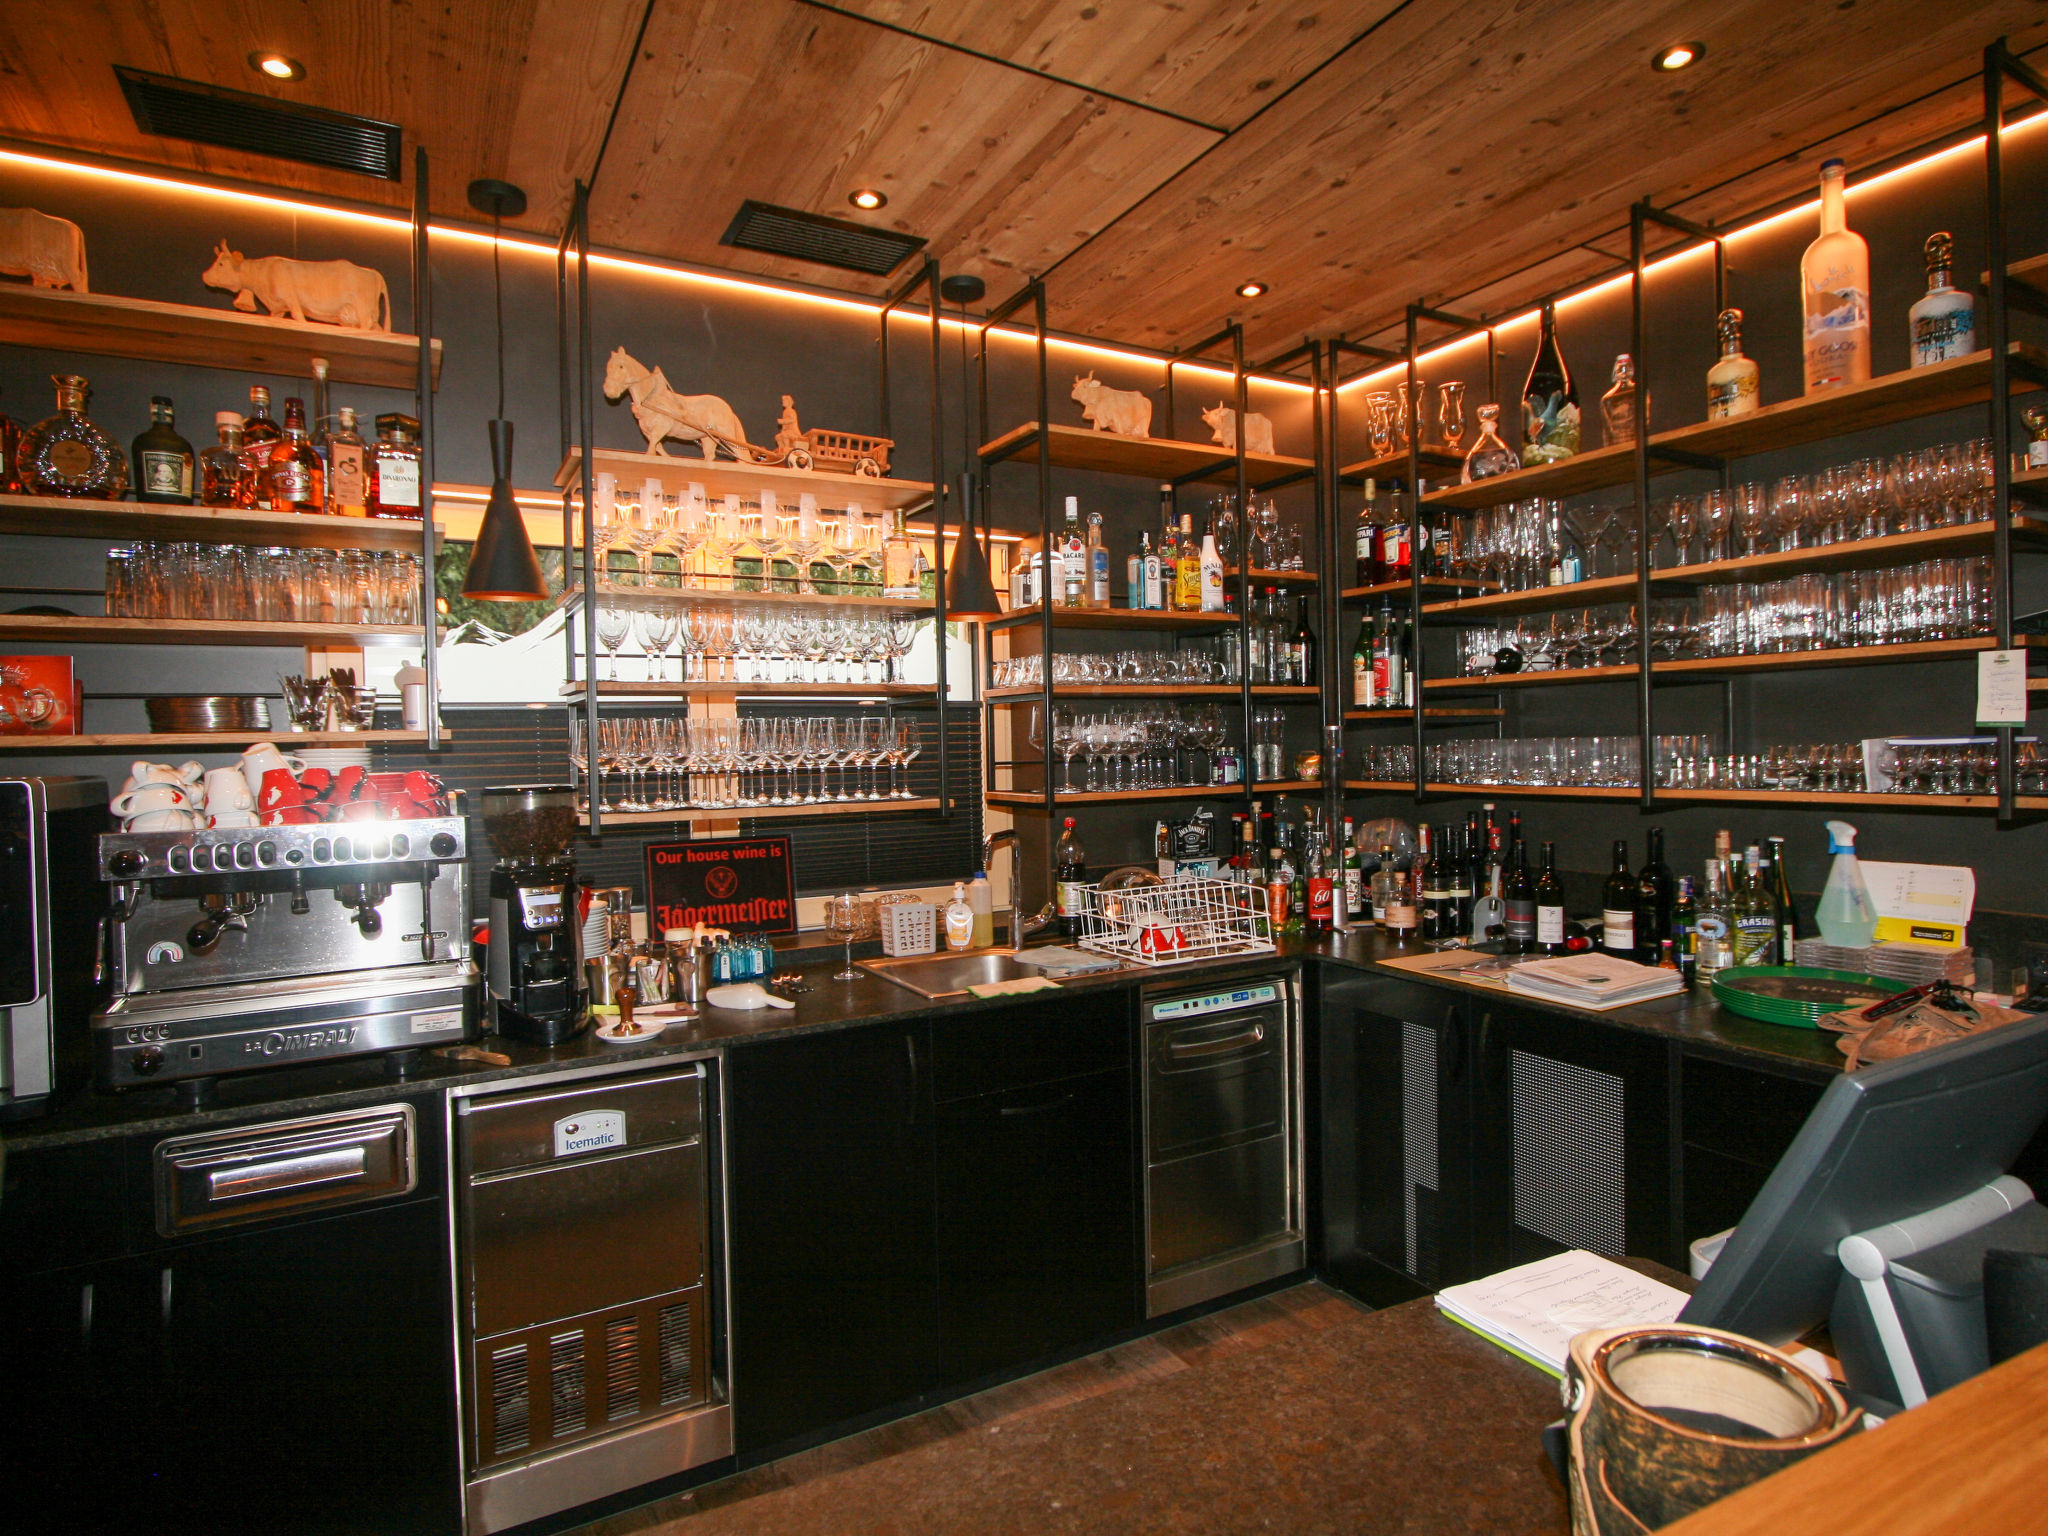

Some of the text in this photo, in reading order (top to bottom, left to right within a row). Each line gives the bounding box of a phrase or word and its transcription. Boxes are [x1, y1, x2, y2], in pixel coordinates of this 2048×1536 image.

[655, 843, 782, 865] Our house wine is
[1314, 889, 1330, 903] 60
[245, 1026, 360, 1057] LA CIMBALI
[565, 1132, 615, 1150] Icematic
